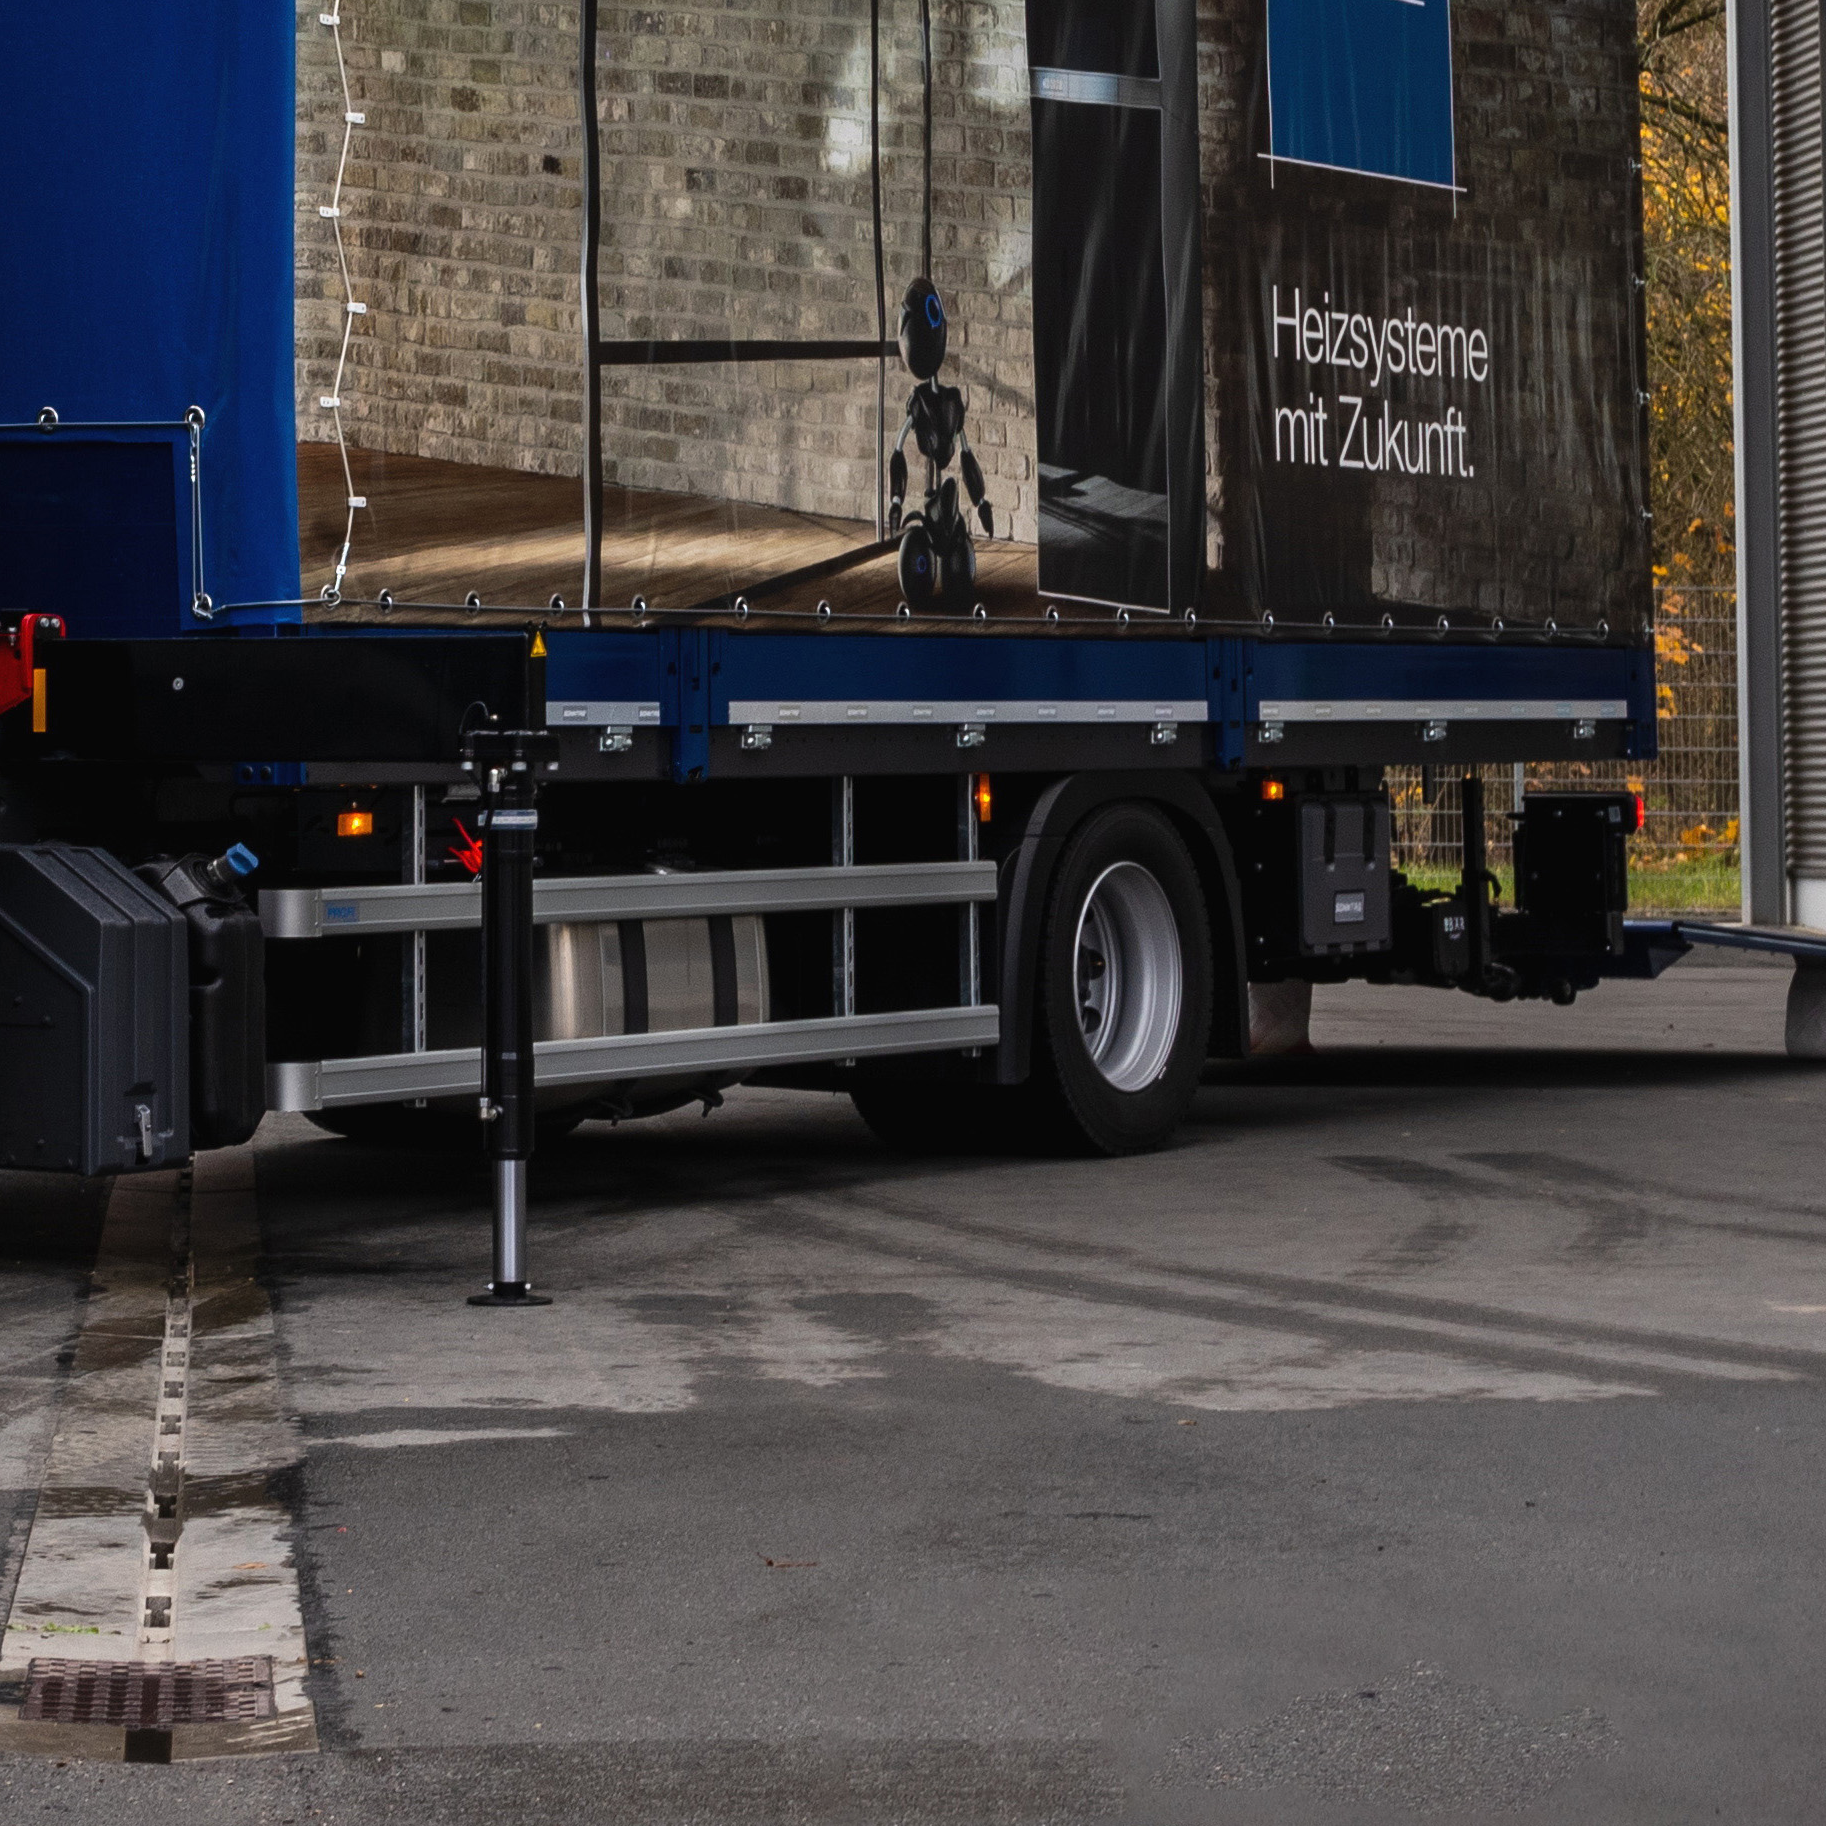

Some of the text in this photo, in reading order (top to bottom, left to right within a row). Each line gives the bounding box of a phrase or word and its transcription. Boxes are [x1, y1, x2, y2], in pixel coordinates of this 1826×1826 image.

[1273, 284, 1488, 387] Heizsysteme
[1275, 392, 1474, 478] mit Zukunft.
